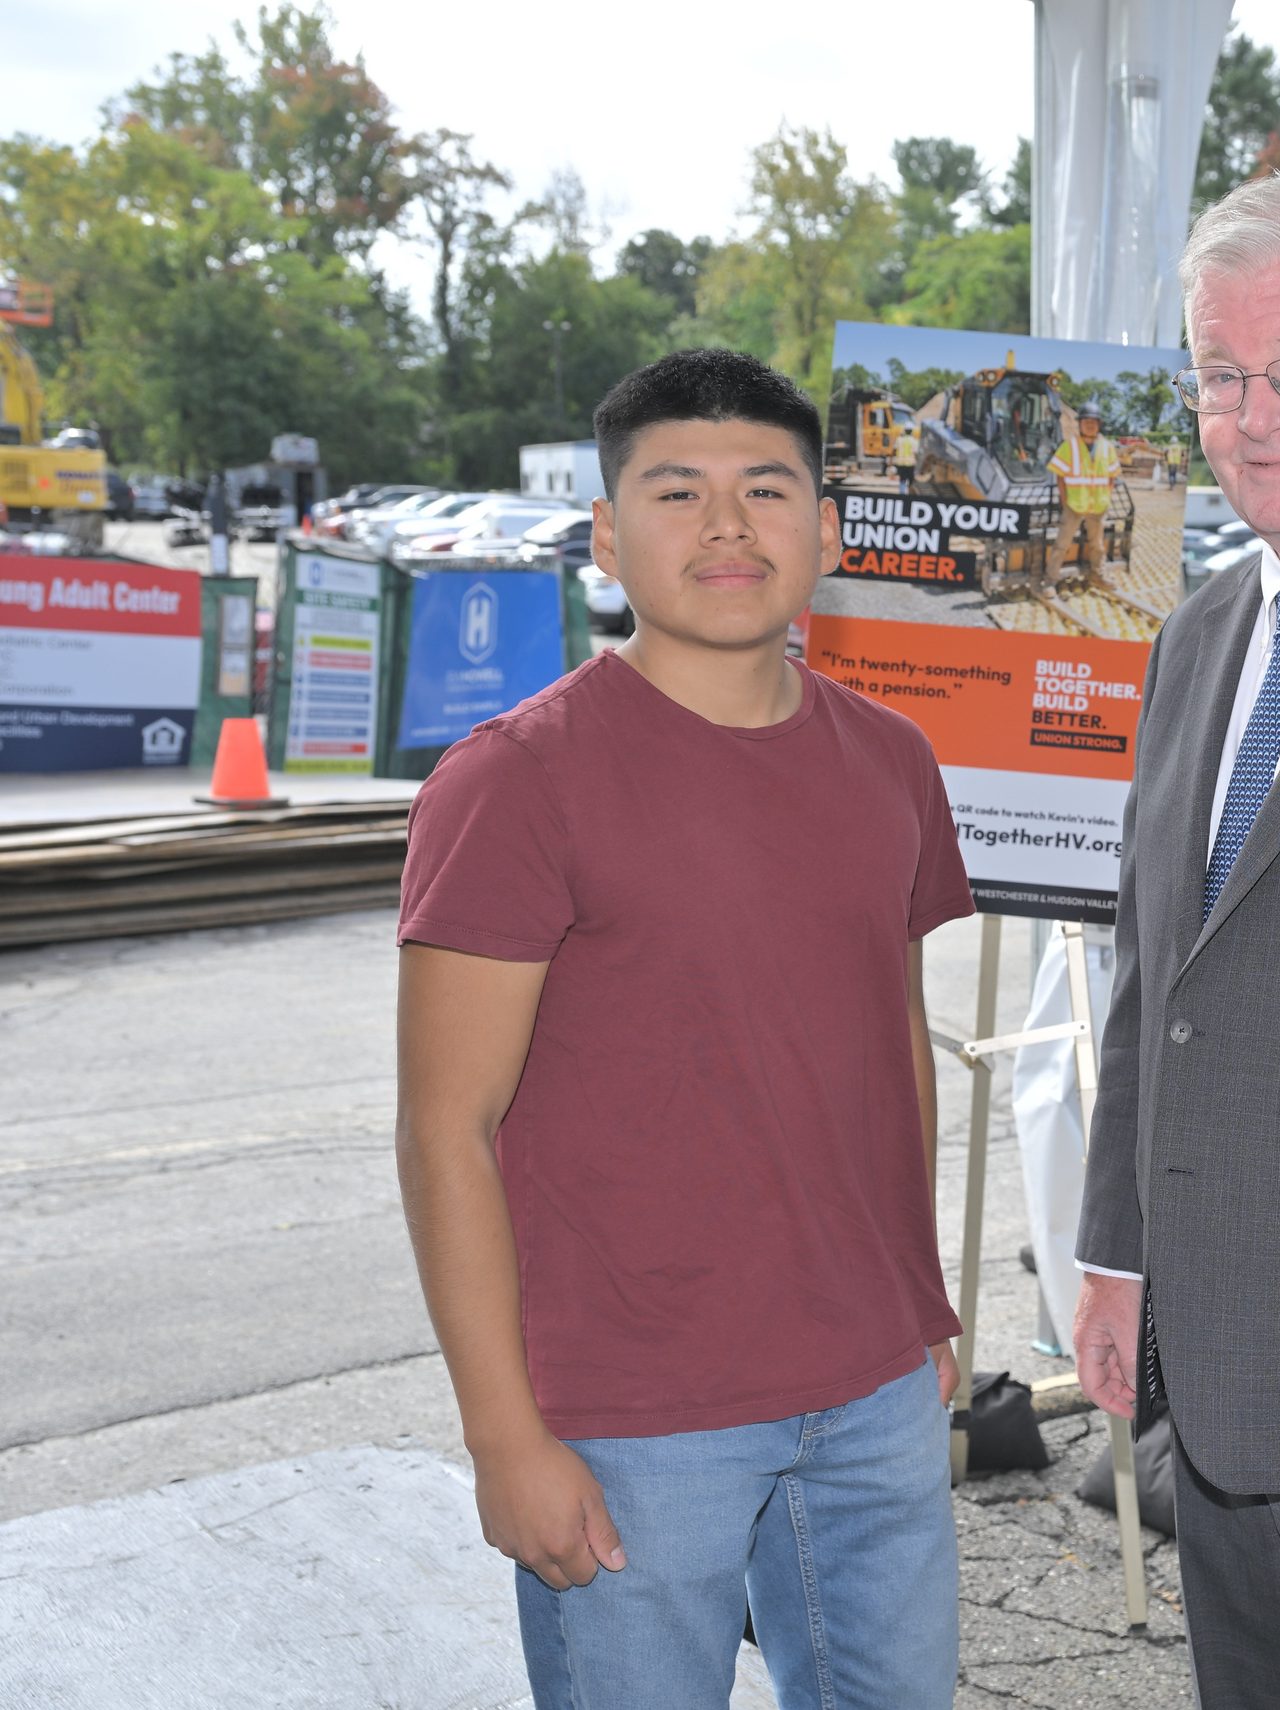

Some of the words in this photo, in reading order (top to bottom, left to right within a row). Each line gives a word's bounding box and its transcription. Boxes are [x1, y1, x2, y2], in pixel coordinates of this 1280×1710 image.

[845, 496, 933, 526] BUILD
[937, 503, 1020, 534] YOUR
[842, 522, 940, 553] UNION
[840, 549, 965, 582] CAREER.
[49, 577, 110, 610] Adult
[113, 582, 181, 615] Center
[860, 656, 1012, 686] twenty-something
[1036, 660, 1091, 678] BUILD
[868, 681, 879, 692] a
[1035, 675, 1142, 701] TOGETHER.
[1032, 693, 1089, 712] BUILD
[1032, 710, 1107, 730] BETTER.
[1034, 732, 1072, 745] UNION
[1073, 736, 1123, 749] STRONG.
[957, 804, 973, 813] QR
[975, 806, 999, 816] code
[1001, 808, 1012, 817] to
[1014, 810, 1046, 821] watch
[1048, 812, 1085, 824] Kevin's
[1087, 816, 1118, 827] video.
[977, 889, 1039, 903] WESTCHESTER
[1046, 895, 1085, 907] HUDSON
